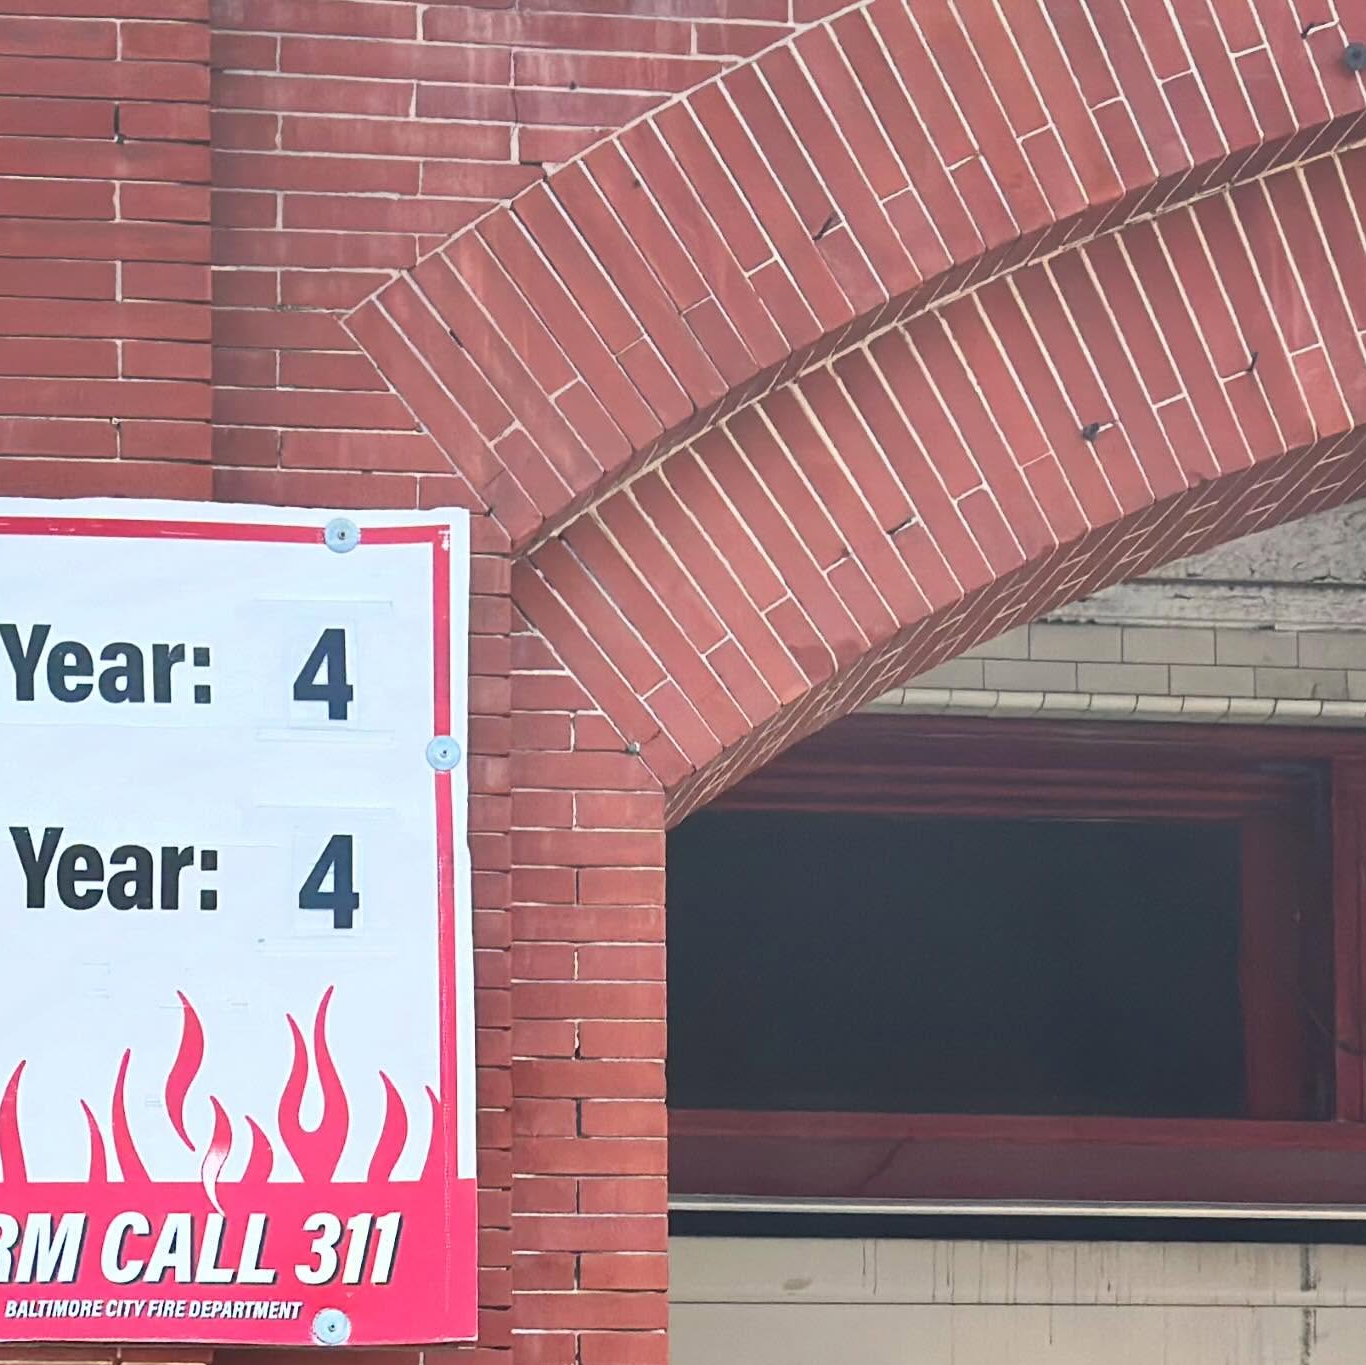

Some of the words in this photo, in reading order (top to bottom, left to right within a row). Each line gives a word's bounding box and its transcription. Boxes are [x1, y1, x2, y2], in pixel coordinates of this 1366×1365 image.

[293, 628, 354, 721] 4
[8, 826, 218, 911] Year:
[298, 834, 360, 929] 4
[100, 1212, 277, 1285] CALL
[294, 1212, 402, 1286] 311
[4, 1299, 104, 1319] BALTIMORE
[105, 1299, 146, 1319] CITY
[147, 1299, 186, 1319] FIRE
[188, 1299, 303, 1321] DEPARTMENT
